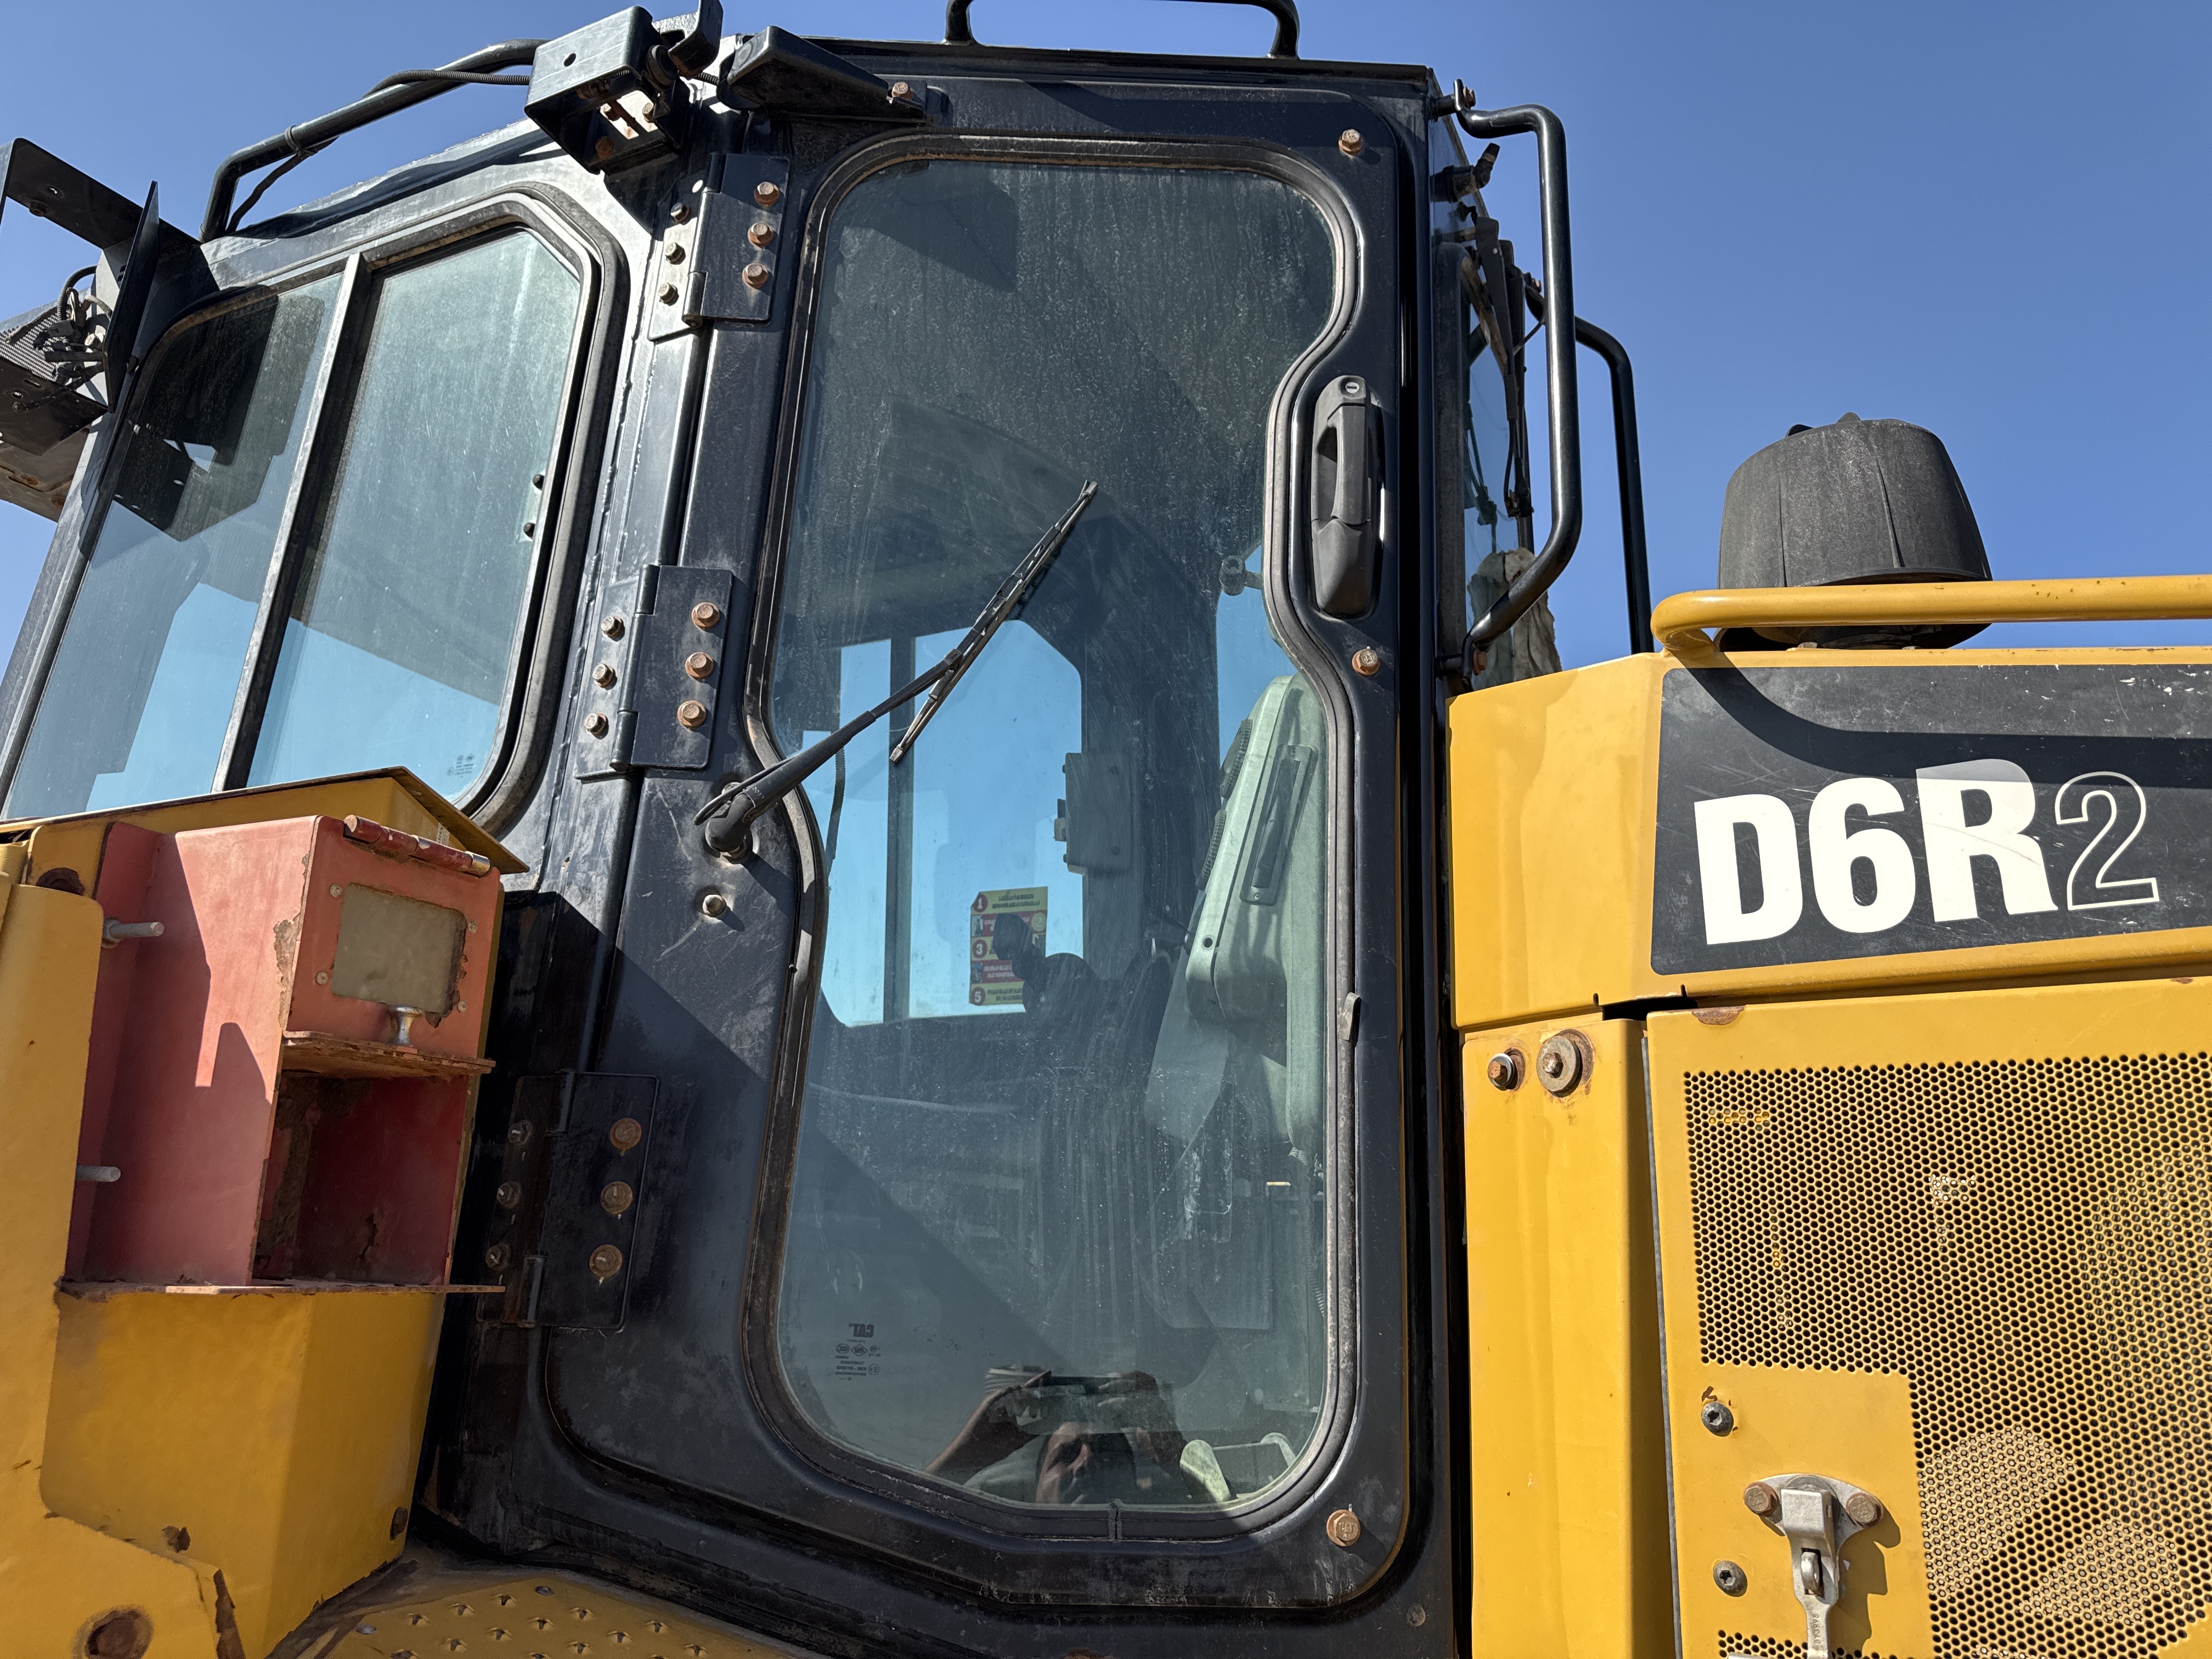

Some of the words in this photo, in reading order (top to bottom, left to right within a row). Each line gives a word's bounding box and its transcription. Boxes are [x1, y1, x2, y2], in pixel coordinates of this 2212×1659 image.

[1694, 759, 2159, 945] D6R2
[977, 898, 983, 909] 1
[1035, 917, 1042, 928] 2
[976, 943, 983, 955] 3
[974, 991, 981, 1003] 5
